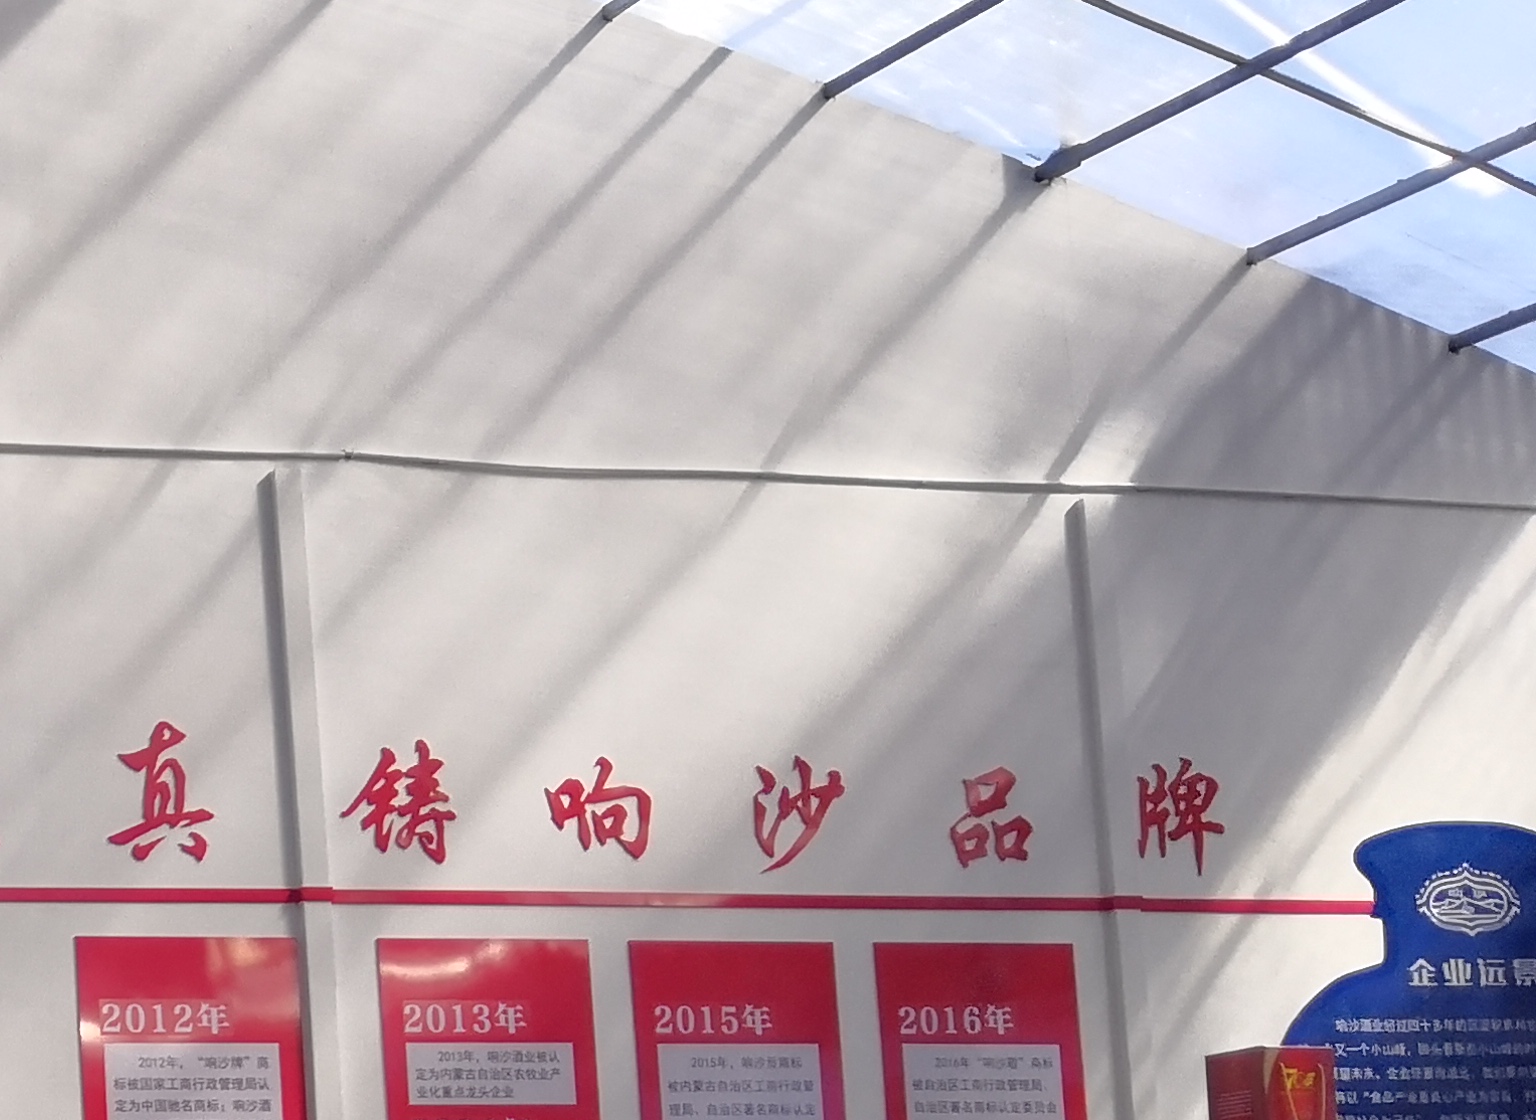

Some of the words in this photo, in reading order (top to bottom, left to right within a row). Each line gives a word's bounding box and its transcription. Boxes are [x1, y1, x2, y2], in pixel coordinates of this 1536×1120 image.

[102, 1002, 230, 1035] 2012年
[403, 1002, 527, 1034] 2013年
[654, 1004, 773, 1036] 2015年
[898, 1003, 1014, 1035] 2016年
